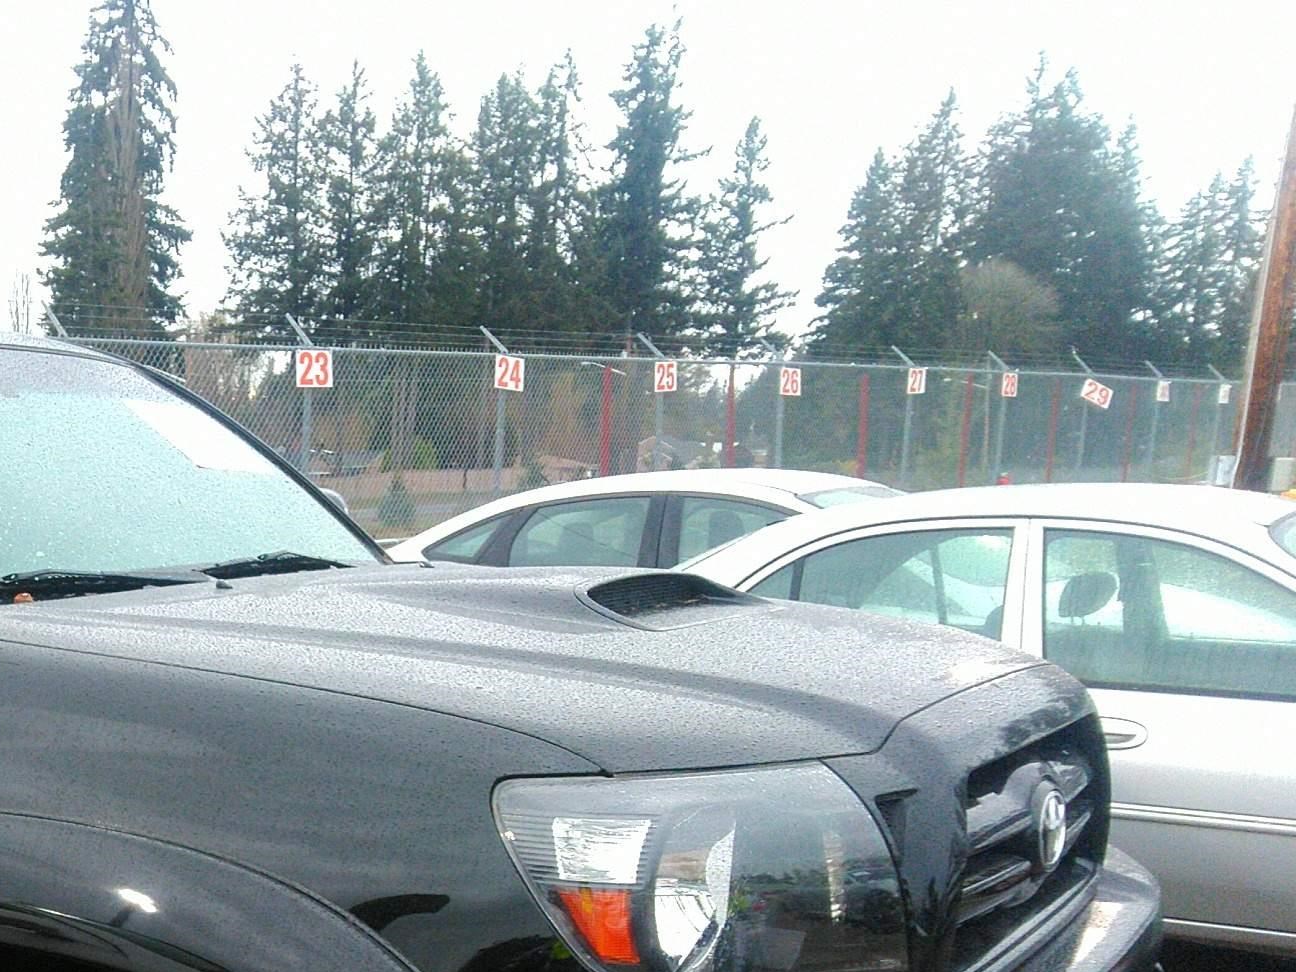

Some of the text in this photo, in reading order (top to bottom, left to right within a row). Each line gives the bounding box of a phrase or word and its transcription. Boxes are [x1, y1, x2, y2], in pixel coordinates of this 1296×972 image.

[299, 351, 329, 386] 23
[497, 356, 522, 390] 24
[656, 363, 675, 390] 25
[909, 369, 923, 393] 27
[781, 369, 799, 394] 26
[1003, 374, 1017, 396] 28
[1083, 381, 1111, 406] 29
